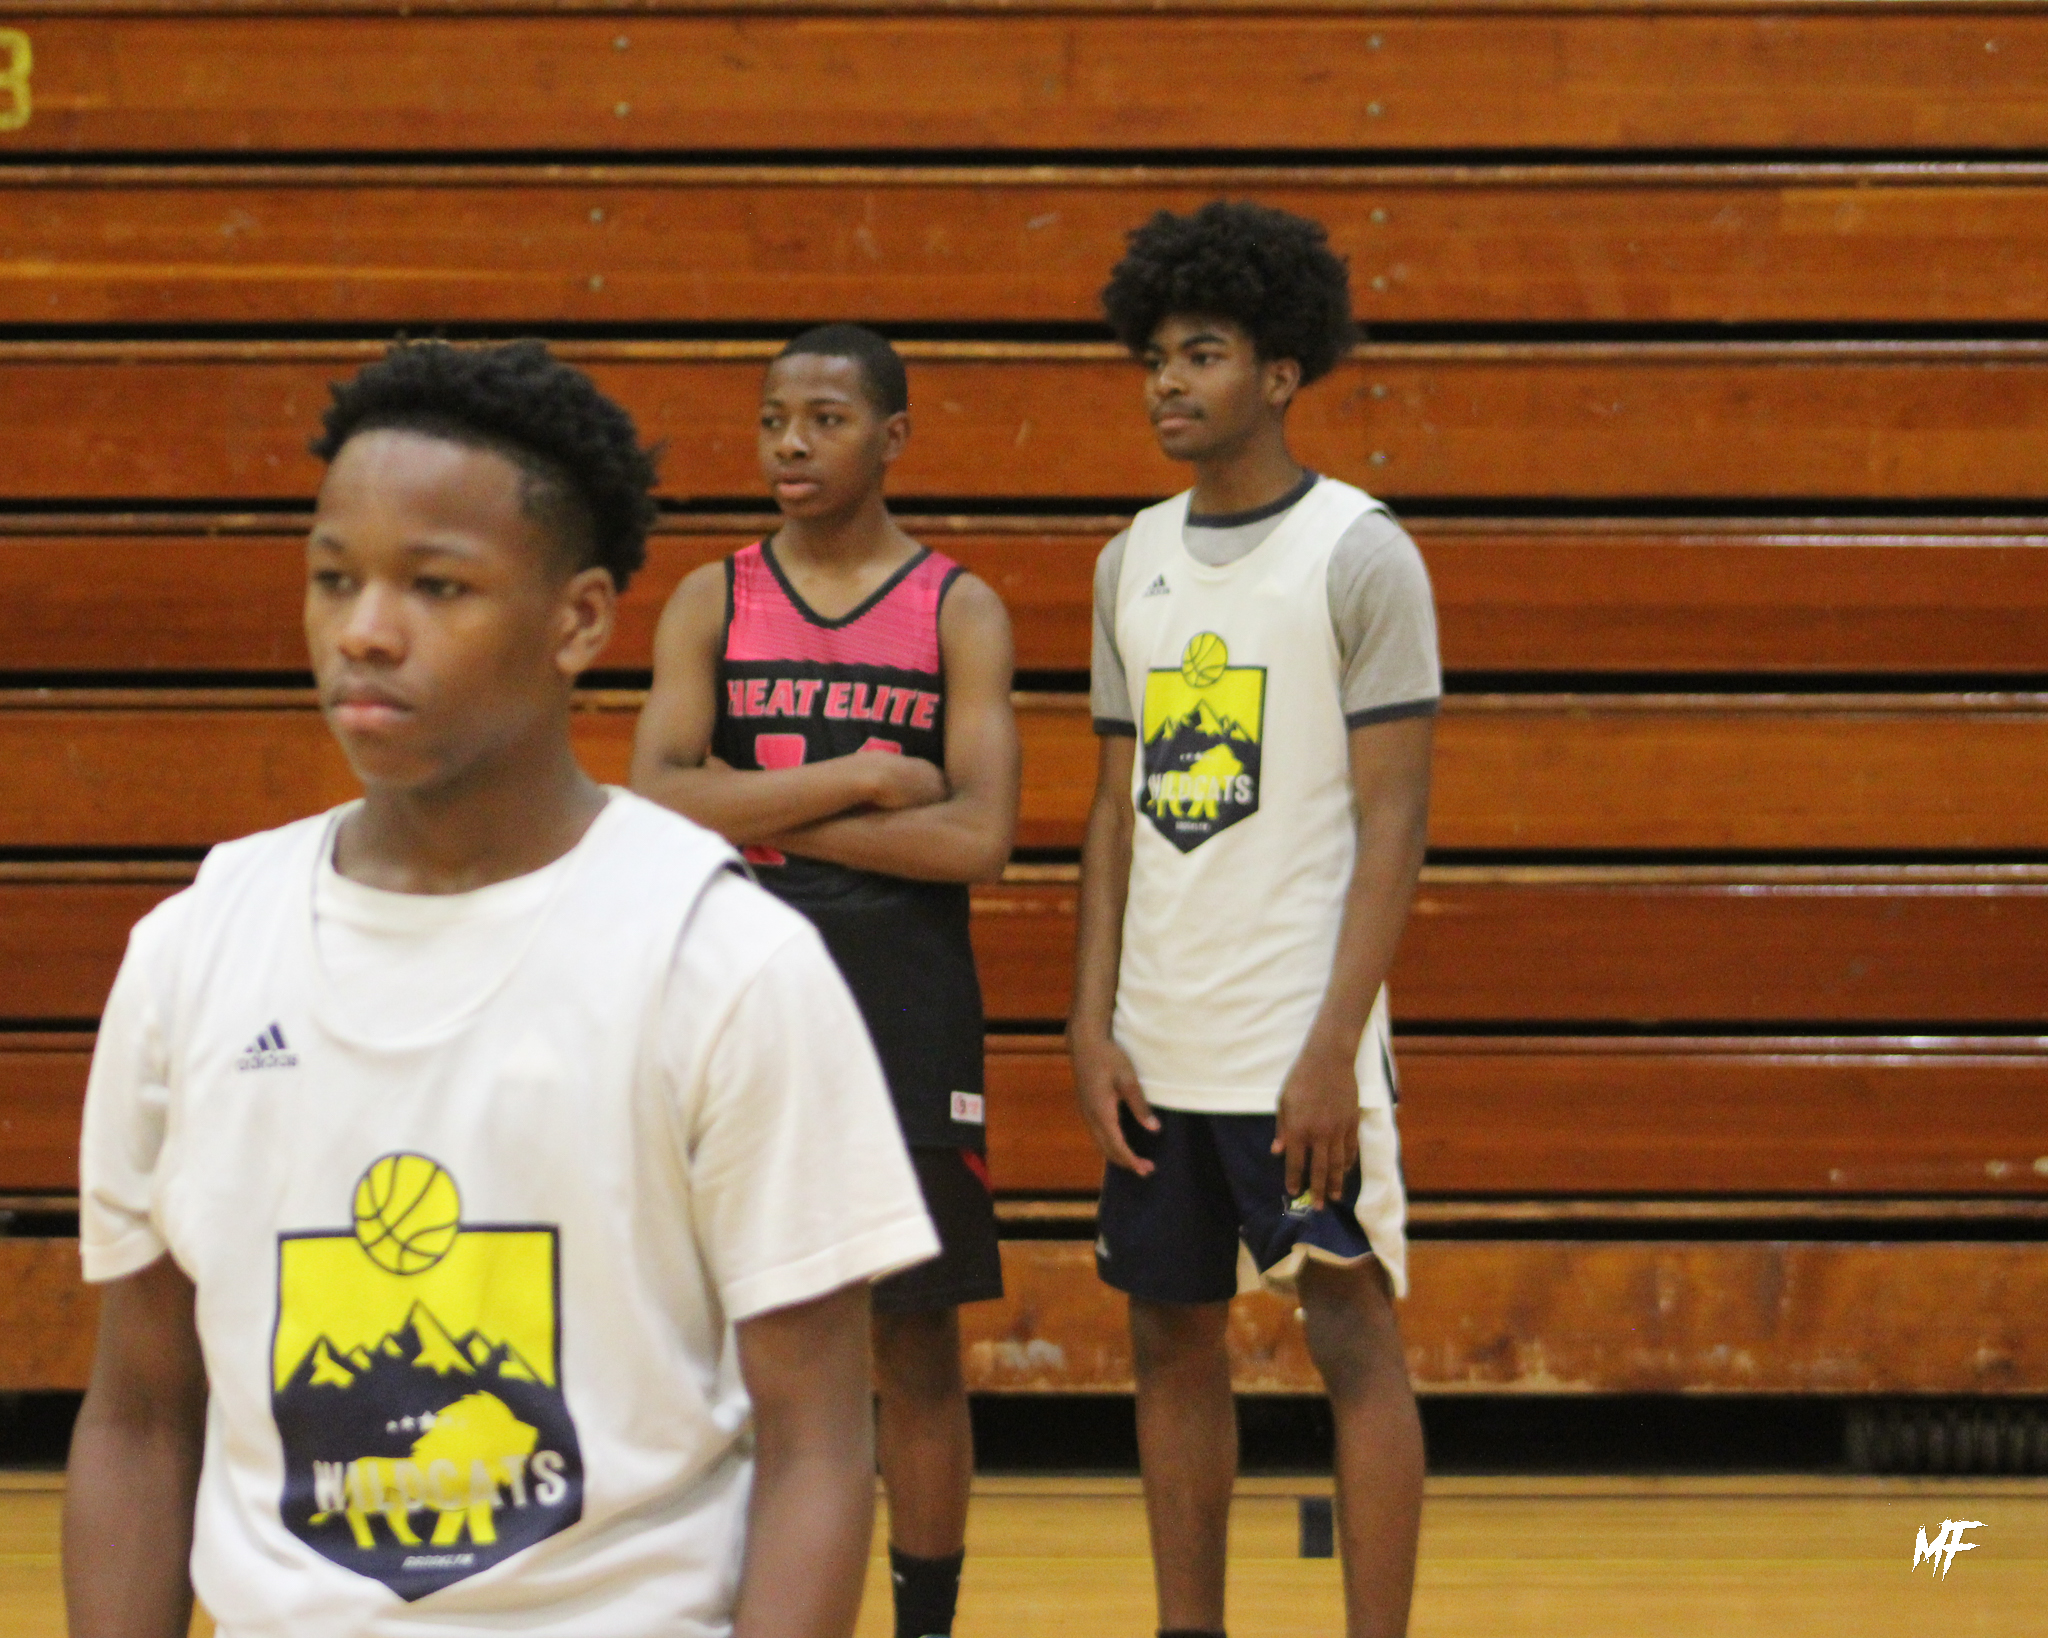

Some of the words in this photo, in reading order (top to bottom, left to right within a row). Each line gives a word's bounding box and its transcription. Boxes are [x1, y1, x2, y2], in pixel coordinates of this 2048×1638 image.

[727, 678, 823, 717] HEAT
[823, 681, 940, 730] ELITE
[1147, 773, 1254, 806] WILDCATS
[312, 1449, 568, 1515] WILDCATS
